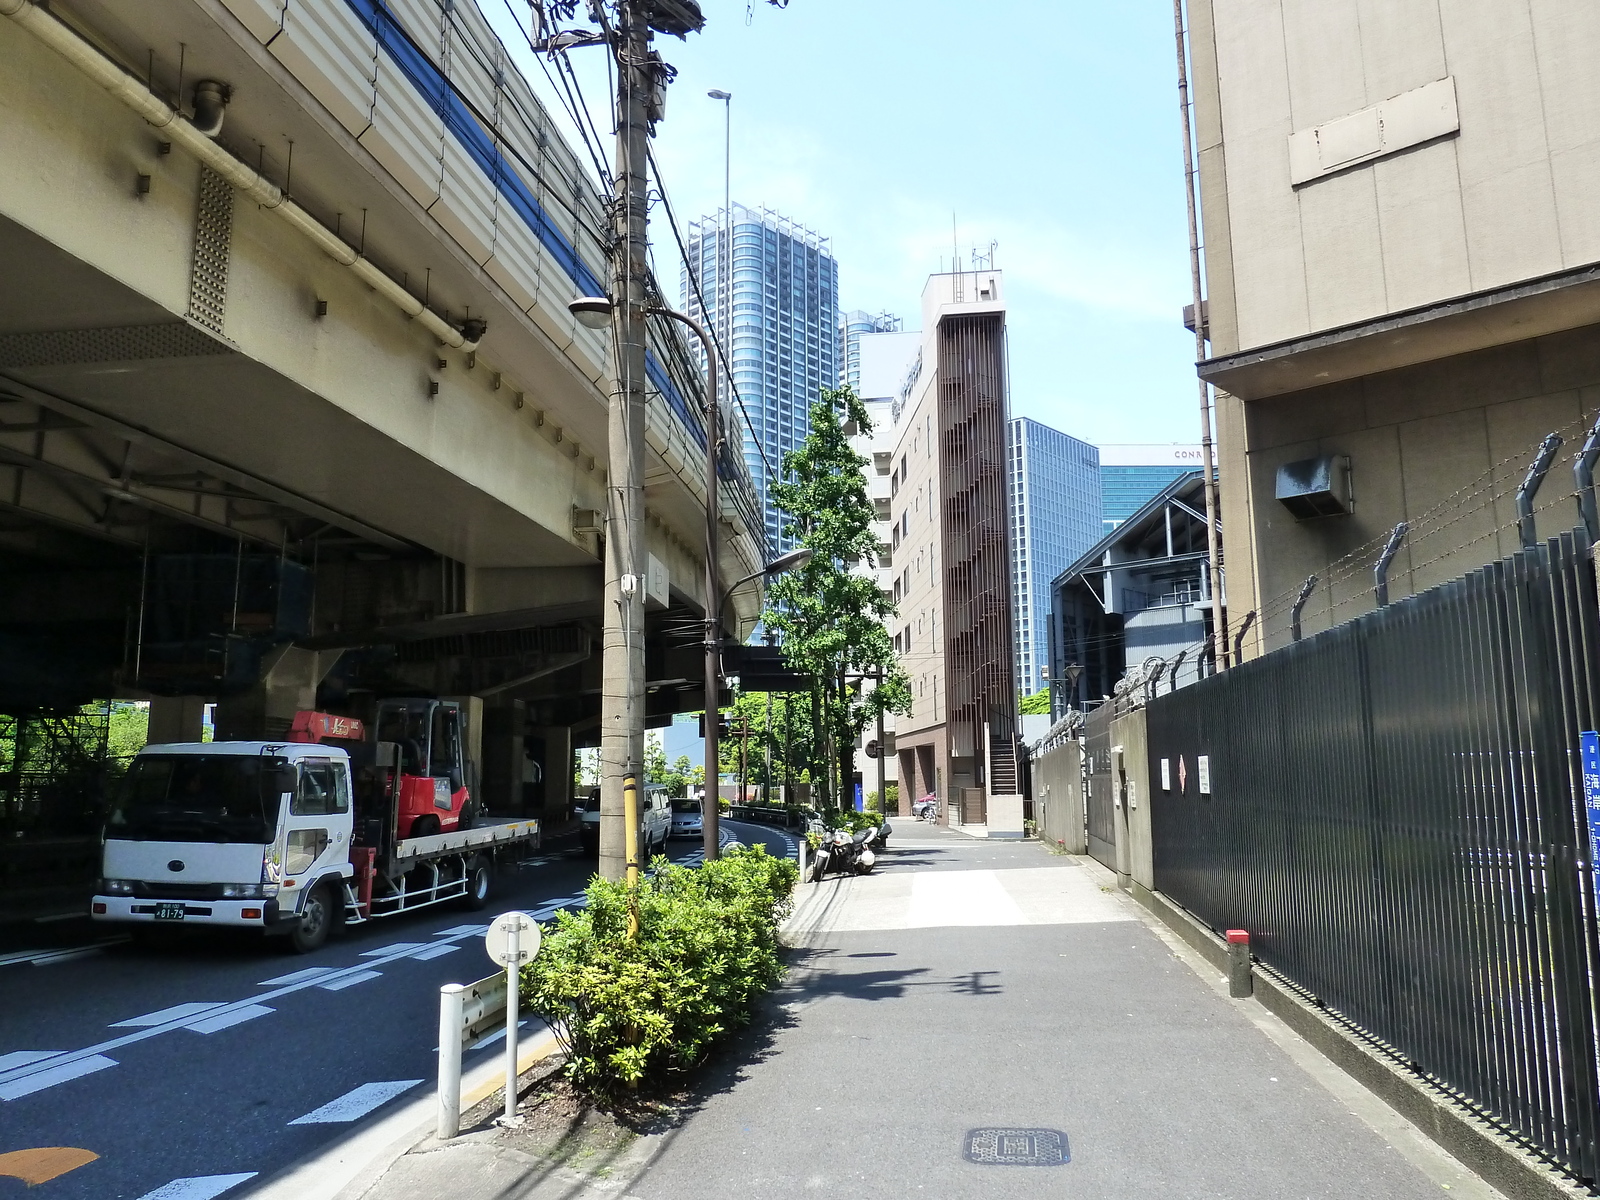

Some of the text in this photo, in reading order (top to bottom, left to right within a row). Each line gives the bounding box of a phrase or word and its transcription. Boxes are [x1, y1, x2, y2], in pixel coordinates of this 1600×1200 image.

[1174, 451, 1215, 459] CONRD
[1584, 773, 1593, 808] KAIGAN
[161, 909, 183, 918] 81-79
